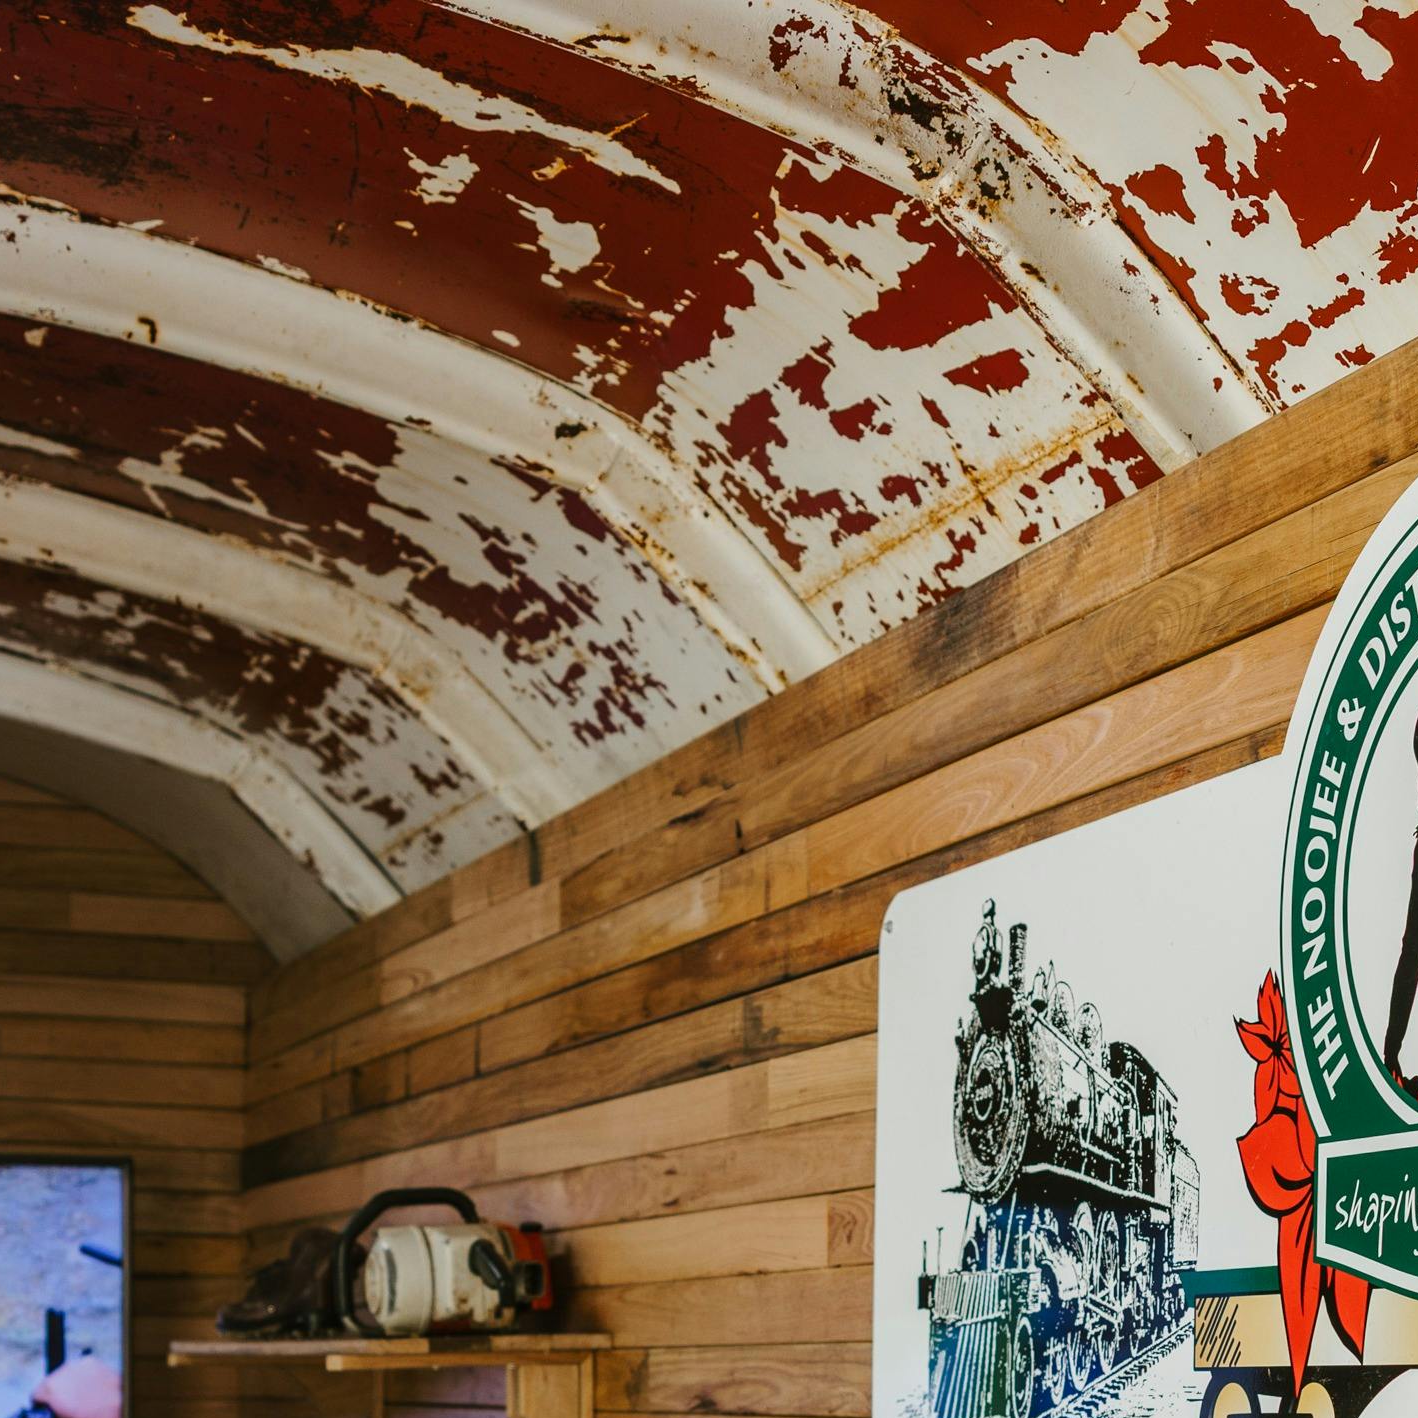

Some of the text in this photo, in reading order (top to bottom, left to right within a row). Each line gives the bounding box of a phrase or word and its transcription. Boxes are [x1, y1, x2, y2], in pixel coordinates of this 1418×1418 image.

[1336, 697, 1367, 742] &
[1300, 748, 1348, 981] NOOJEE
[1306, 986, 1349, 1100] THE
